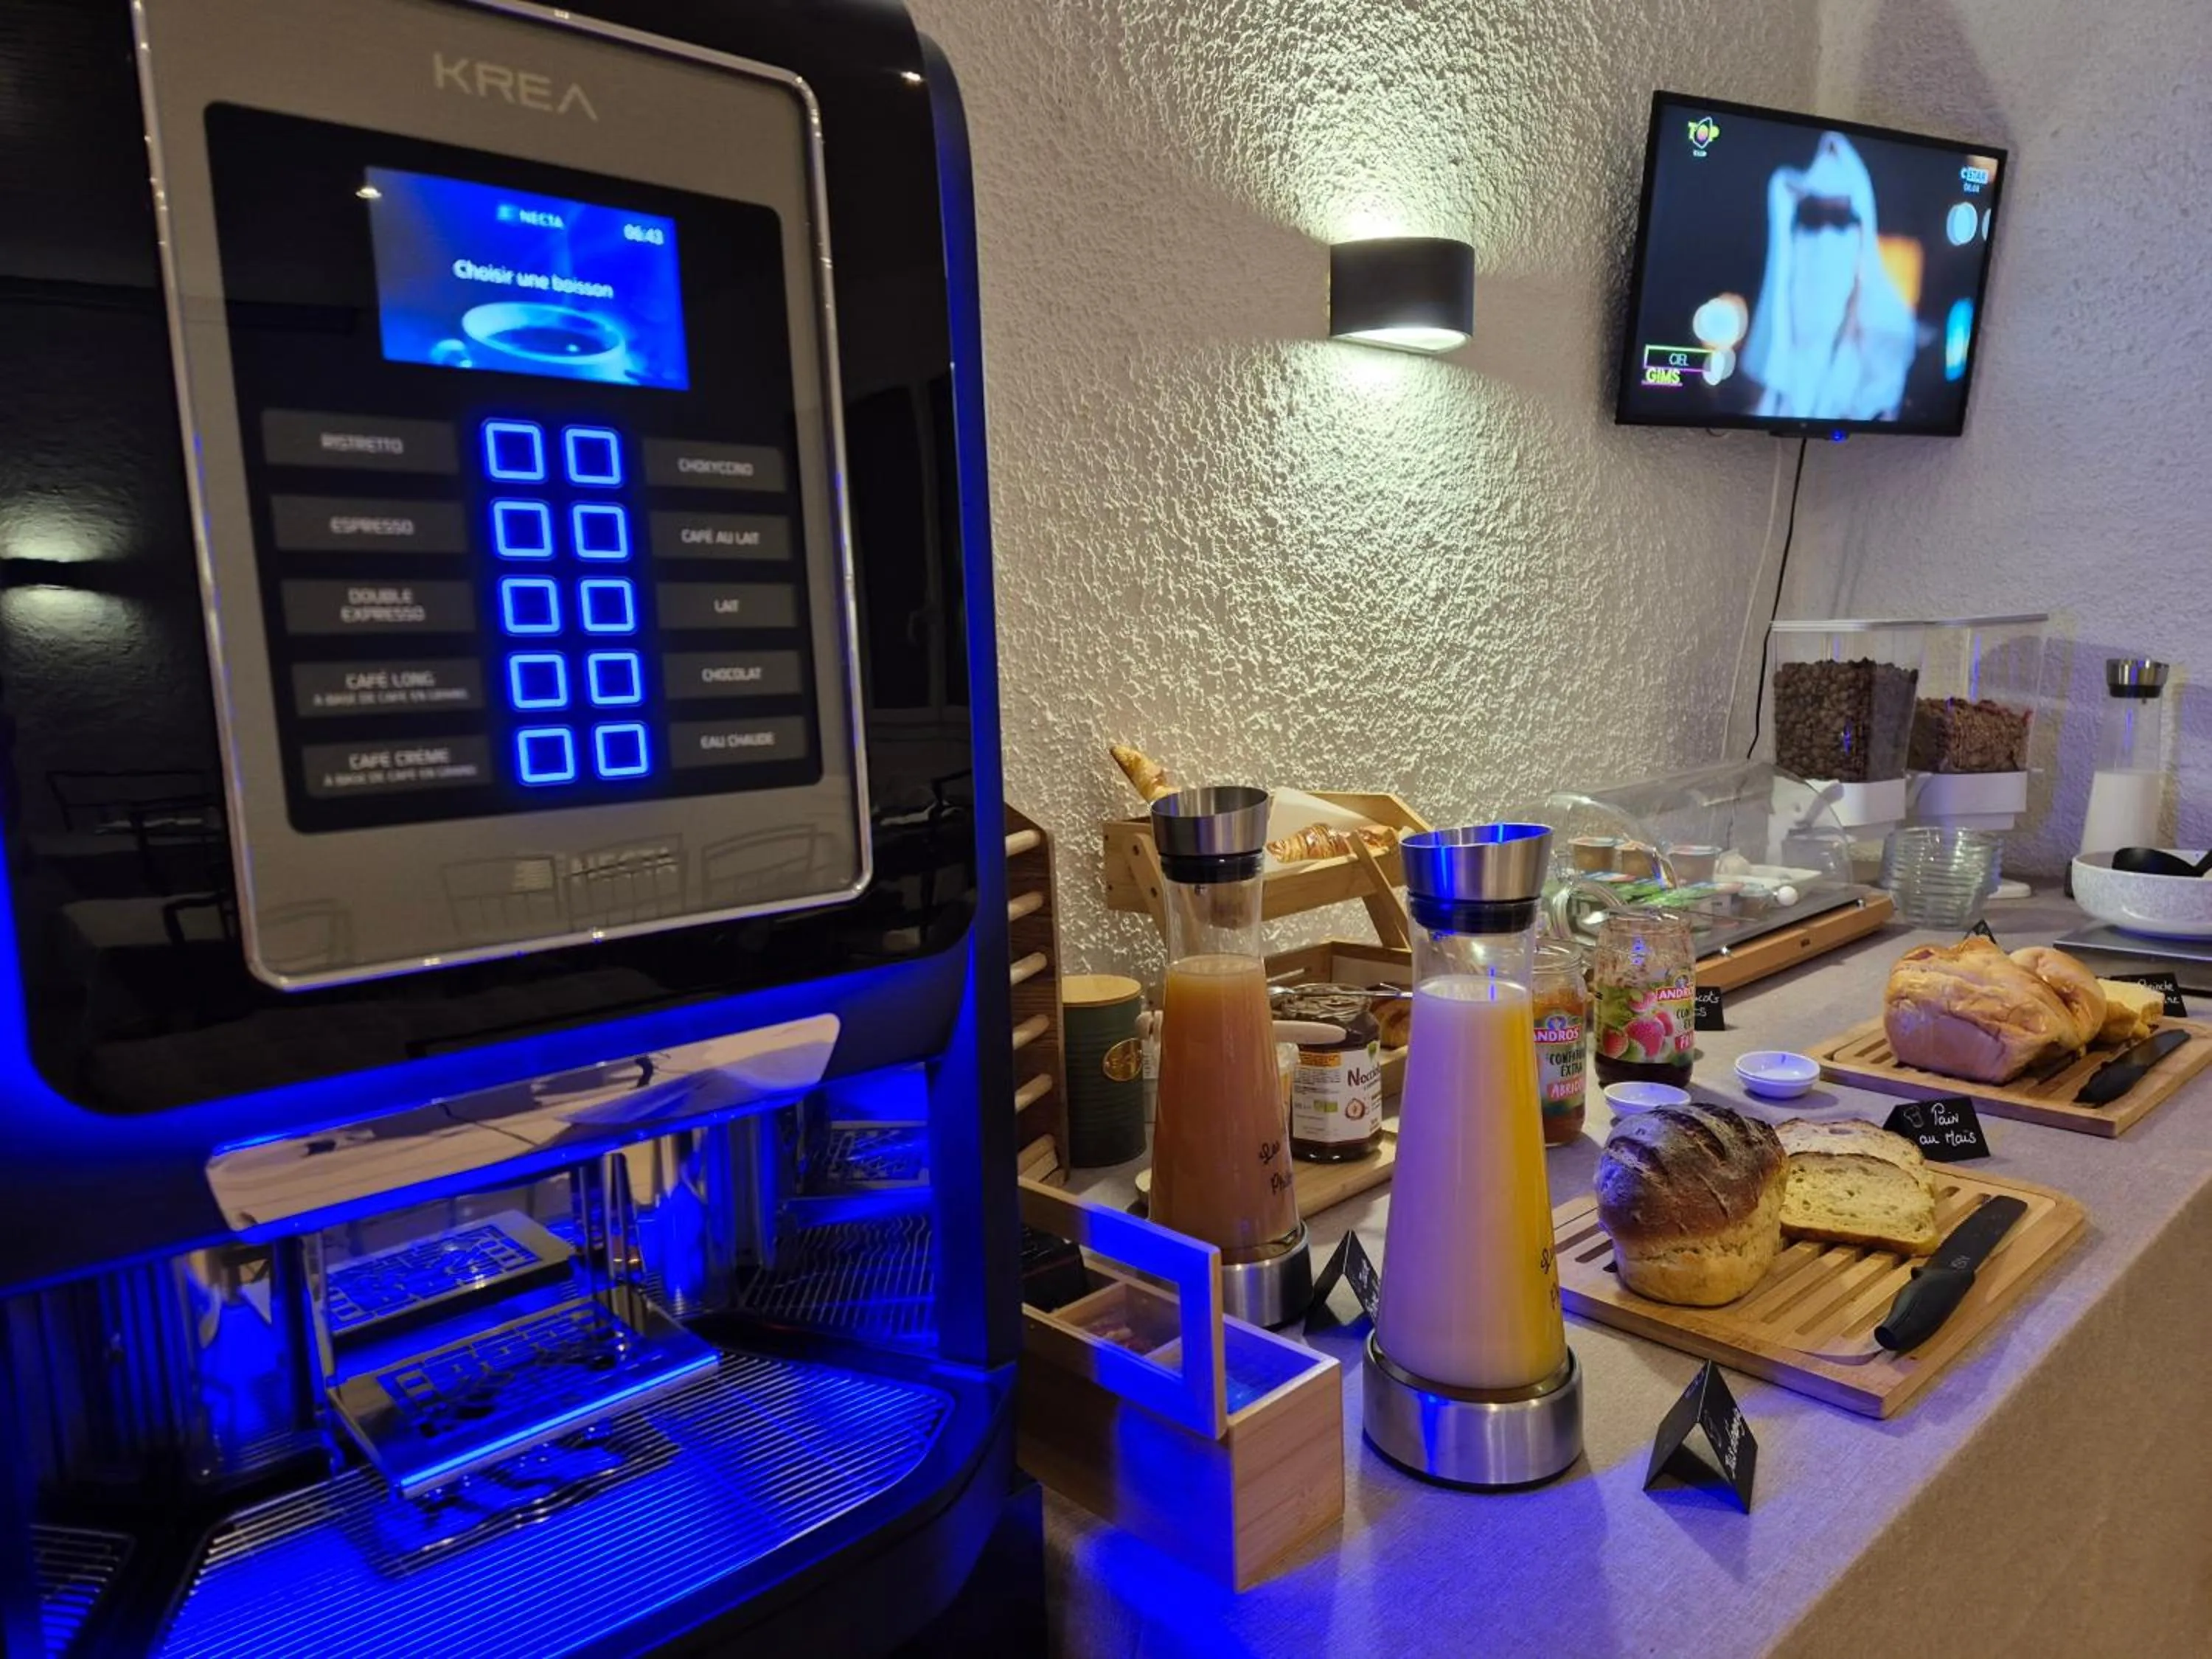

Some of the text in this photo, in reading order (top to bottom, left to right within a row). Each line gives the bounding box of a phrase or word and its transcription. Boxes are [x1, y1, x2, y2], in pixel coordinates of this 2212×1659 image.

[453, 259, 614, 299] Choisir une boisson
[1646, 368, 1681, 384] GIMS
[715, 531, 734, 544] AU
[735, 532, 759, 545] LAIT
[348, 588, 412, 604] DOUBLE
[714, 599, 740, 613] LAIT
[702, 667, 762, 682] CHOCOLAT
[700, 731, 775, 749] EAU CHAUDE
[1919, 1135, 1940, 1145] au
